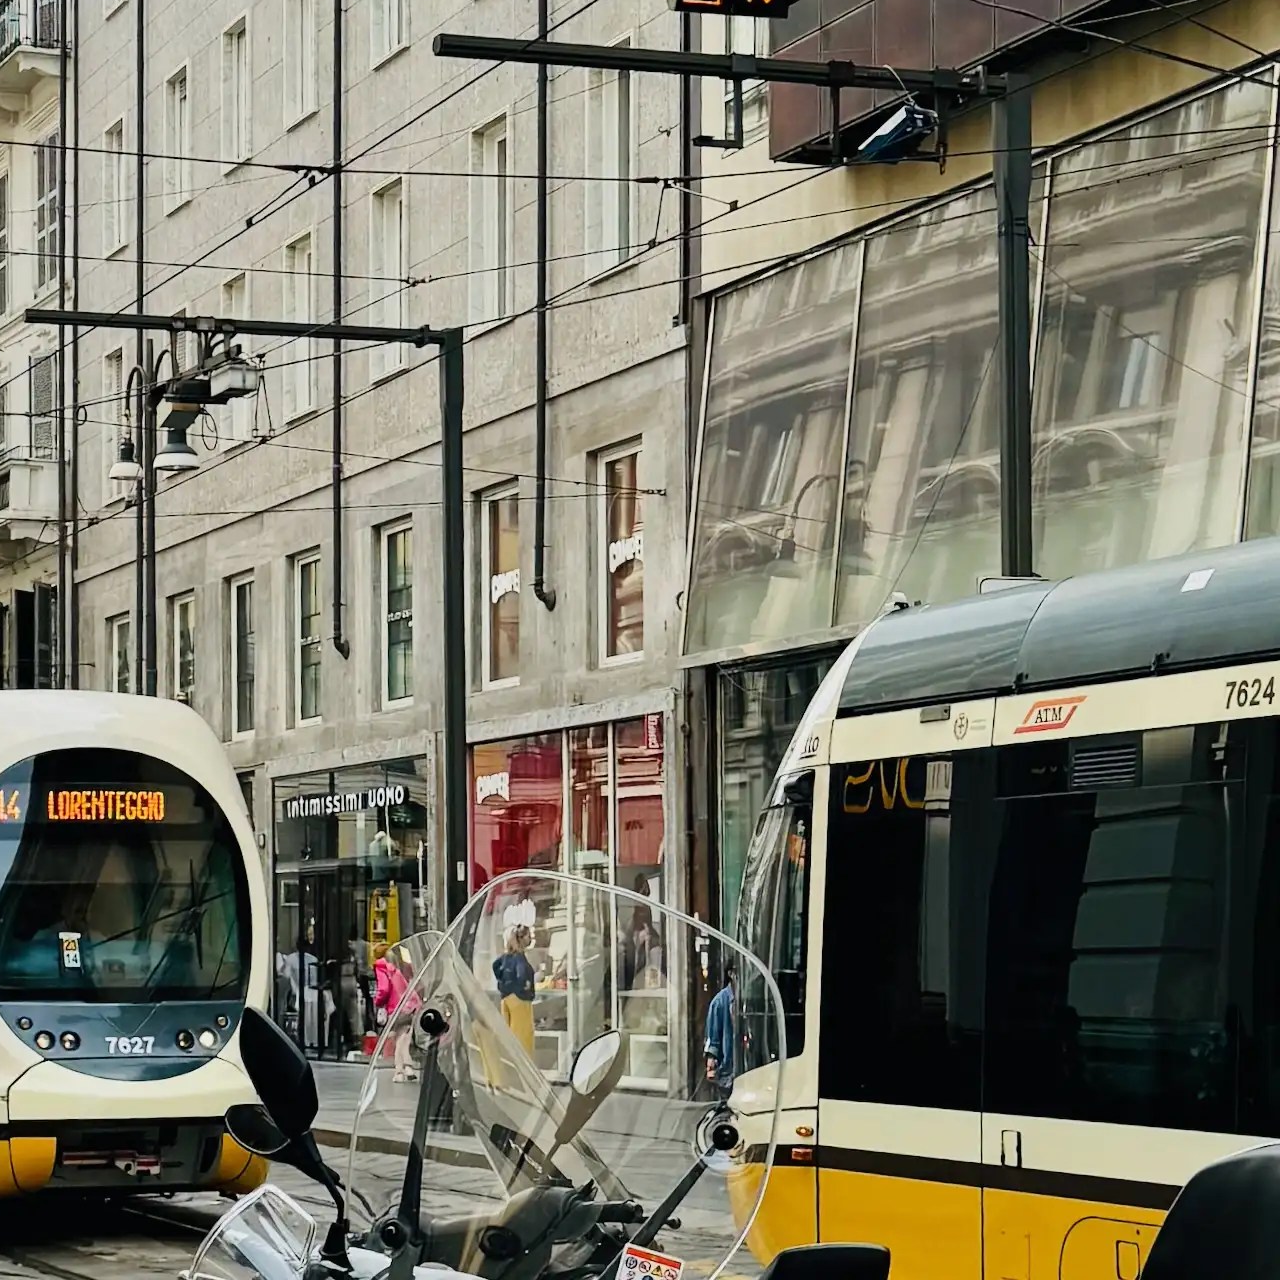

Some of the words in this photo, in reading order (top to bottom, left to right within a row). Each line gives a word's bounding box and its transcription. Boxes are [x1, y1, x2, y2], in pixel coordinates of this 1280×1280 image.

[1225, 676, 1276, 710] 7624
[1034, 706, 1064, 724] ATM
[47, 789, 166, 821] LORENTEGGIO
[367, 784, 405, 808] UOMO
[65, 952, 78, 964] 14
[104, 1035, 156, 1055] 7627
